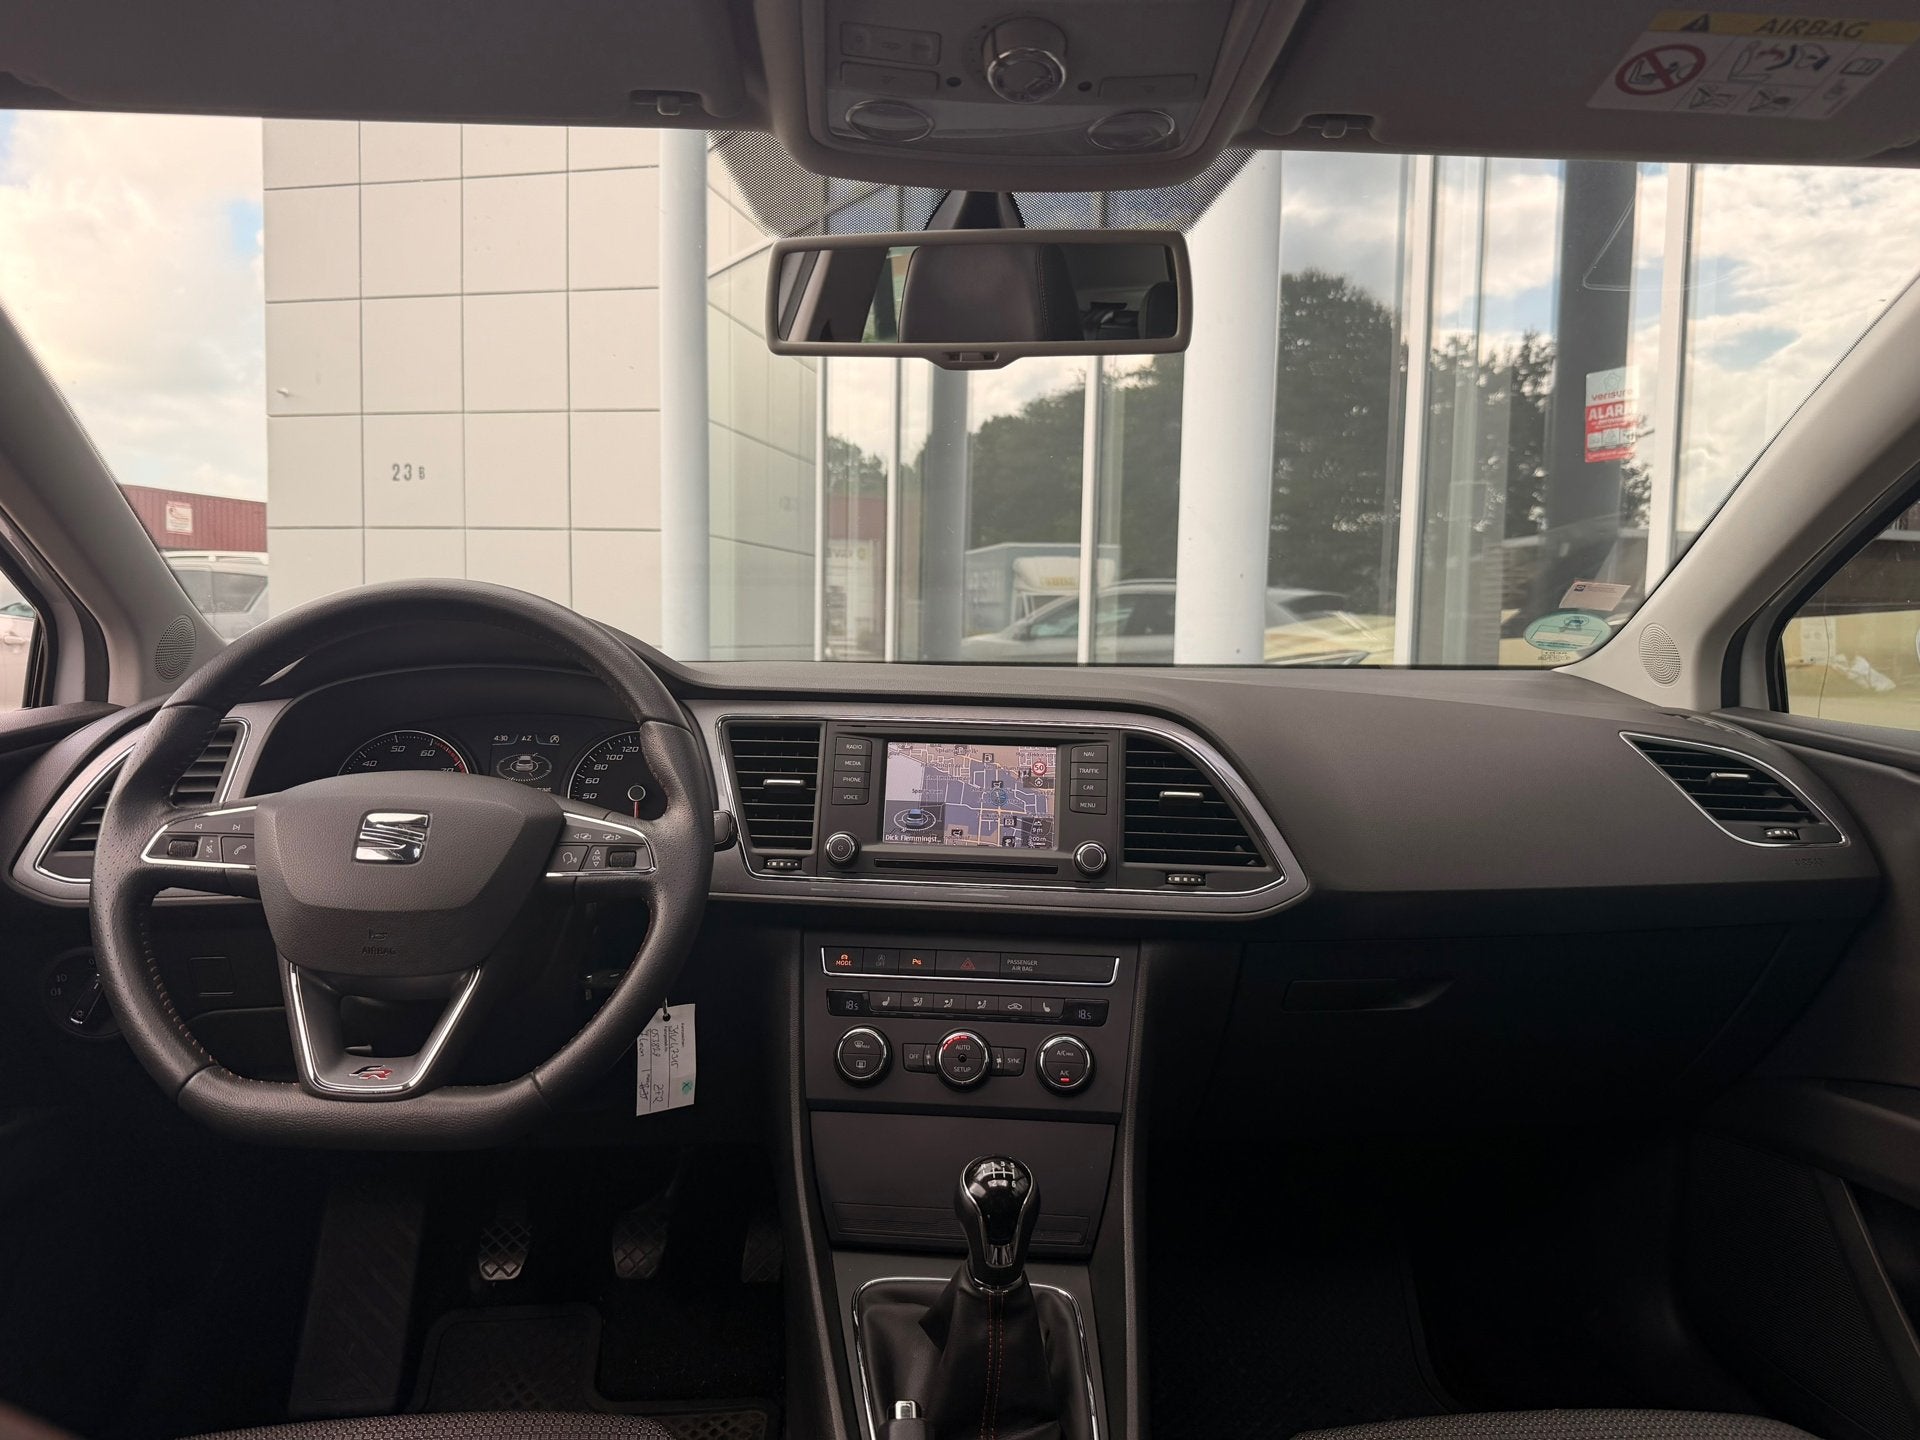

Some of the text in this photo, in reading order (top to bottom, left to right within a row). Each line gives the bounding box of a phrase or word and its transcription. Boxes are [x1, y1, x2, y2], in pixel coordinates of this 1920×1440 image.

[1754, 17, 1870, 38] AIRBAG
[392, 463, 412, 481] 23
[390, 745, 405, 753] 50
[420, 749, 435, 757] 60
[361, 946, 397, 955] AIRBAG
